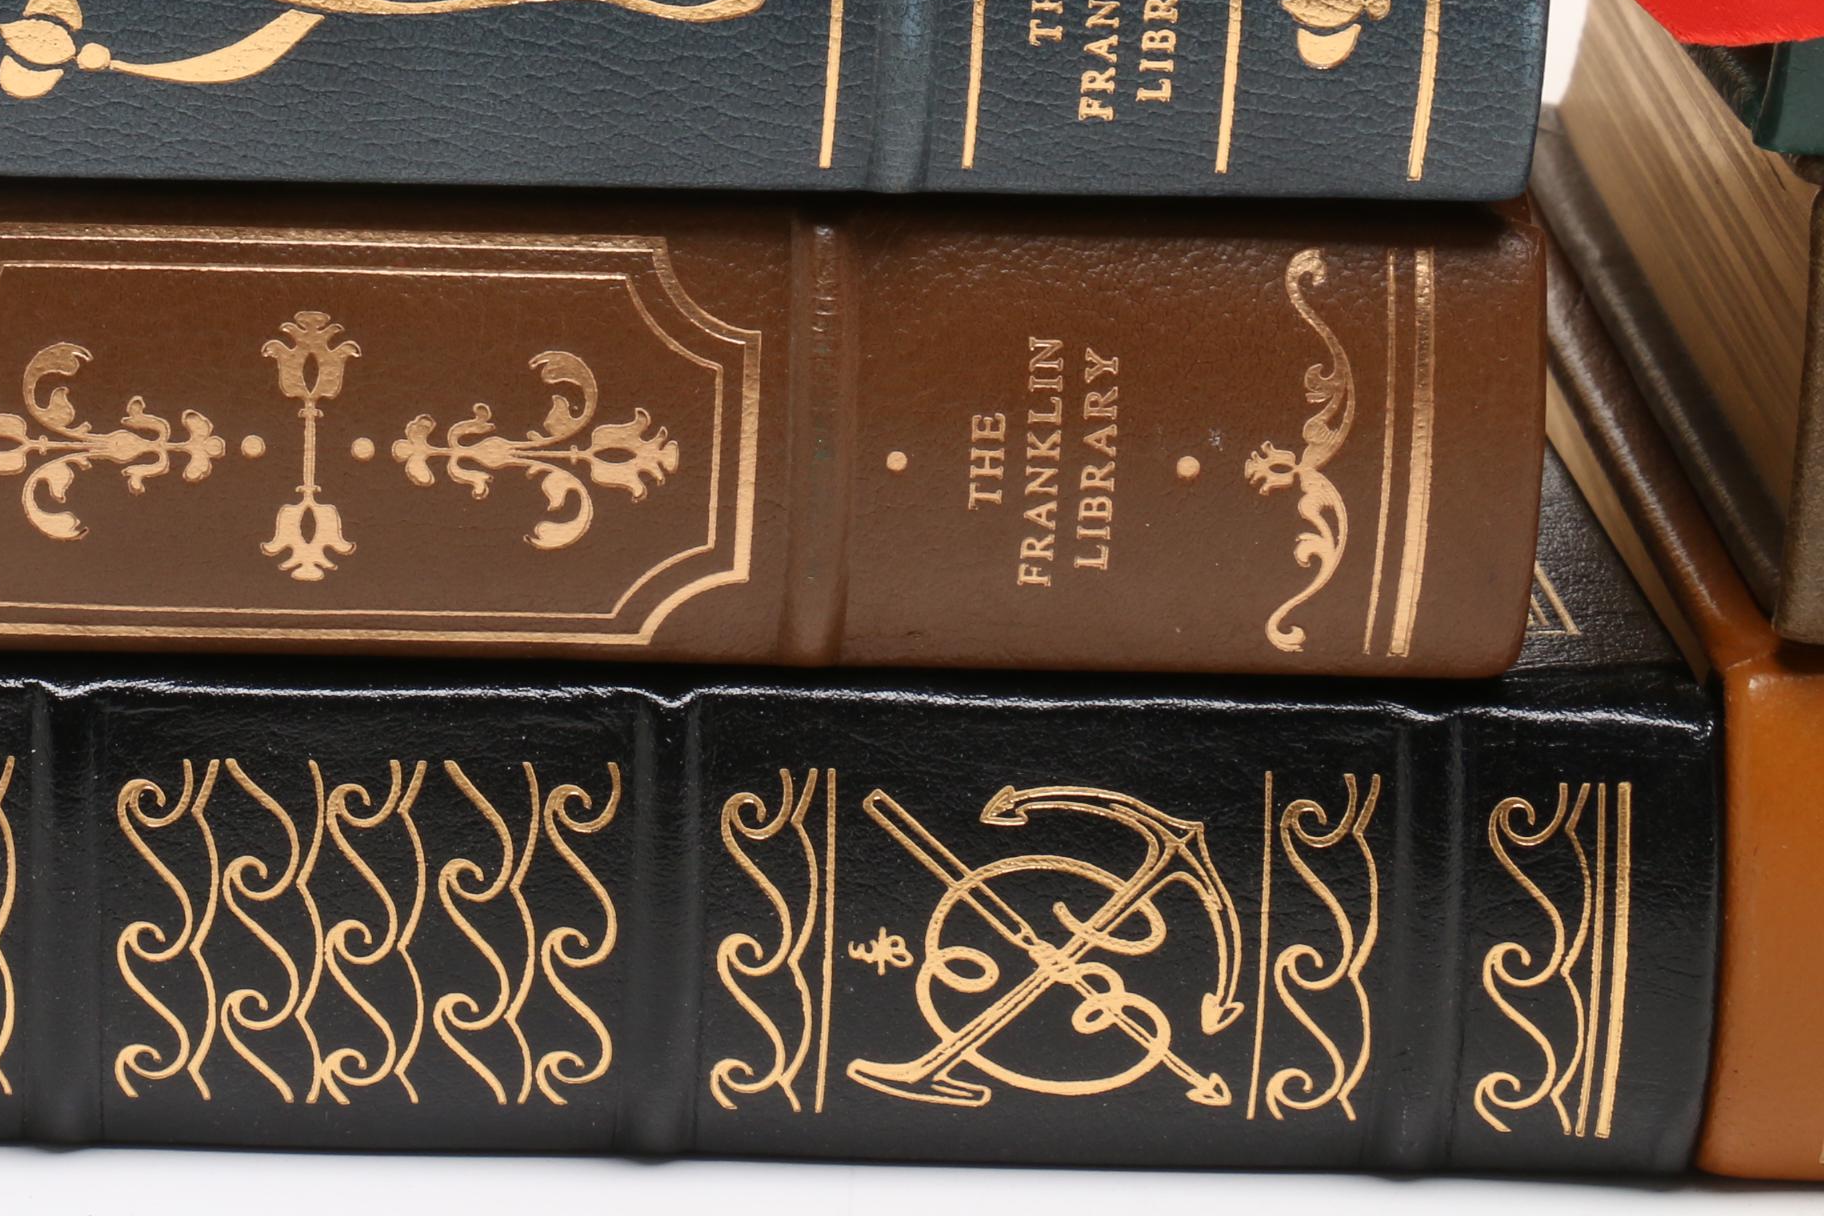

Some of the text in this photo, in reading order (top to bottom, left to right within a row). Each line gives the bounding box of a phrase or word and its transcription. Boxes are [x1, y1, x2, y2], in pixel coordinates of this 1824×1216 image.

[968, 411, 1006, 510] THE
[1017, 336, 1064, 587] FRANKLIN
[1074, 346, 1119, 571] LIBRARY
